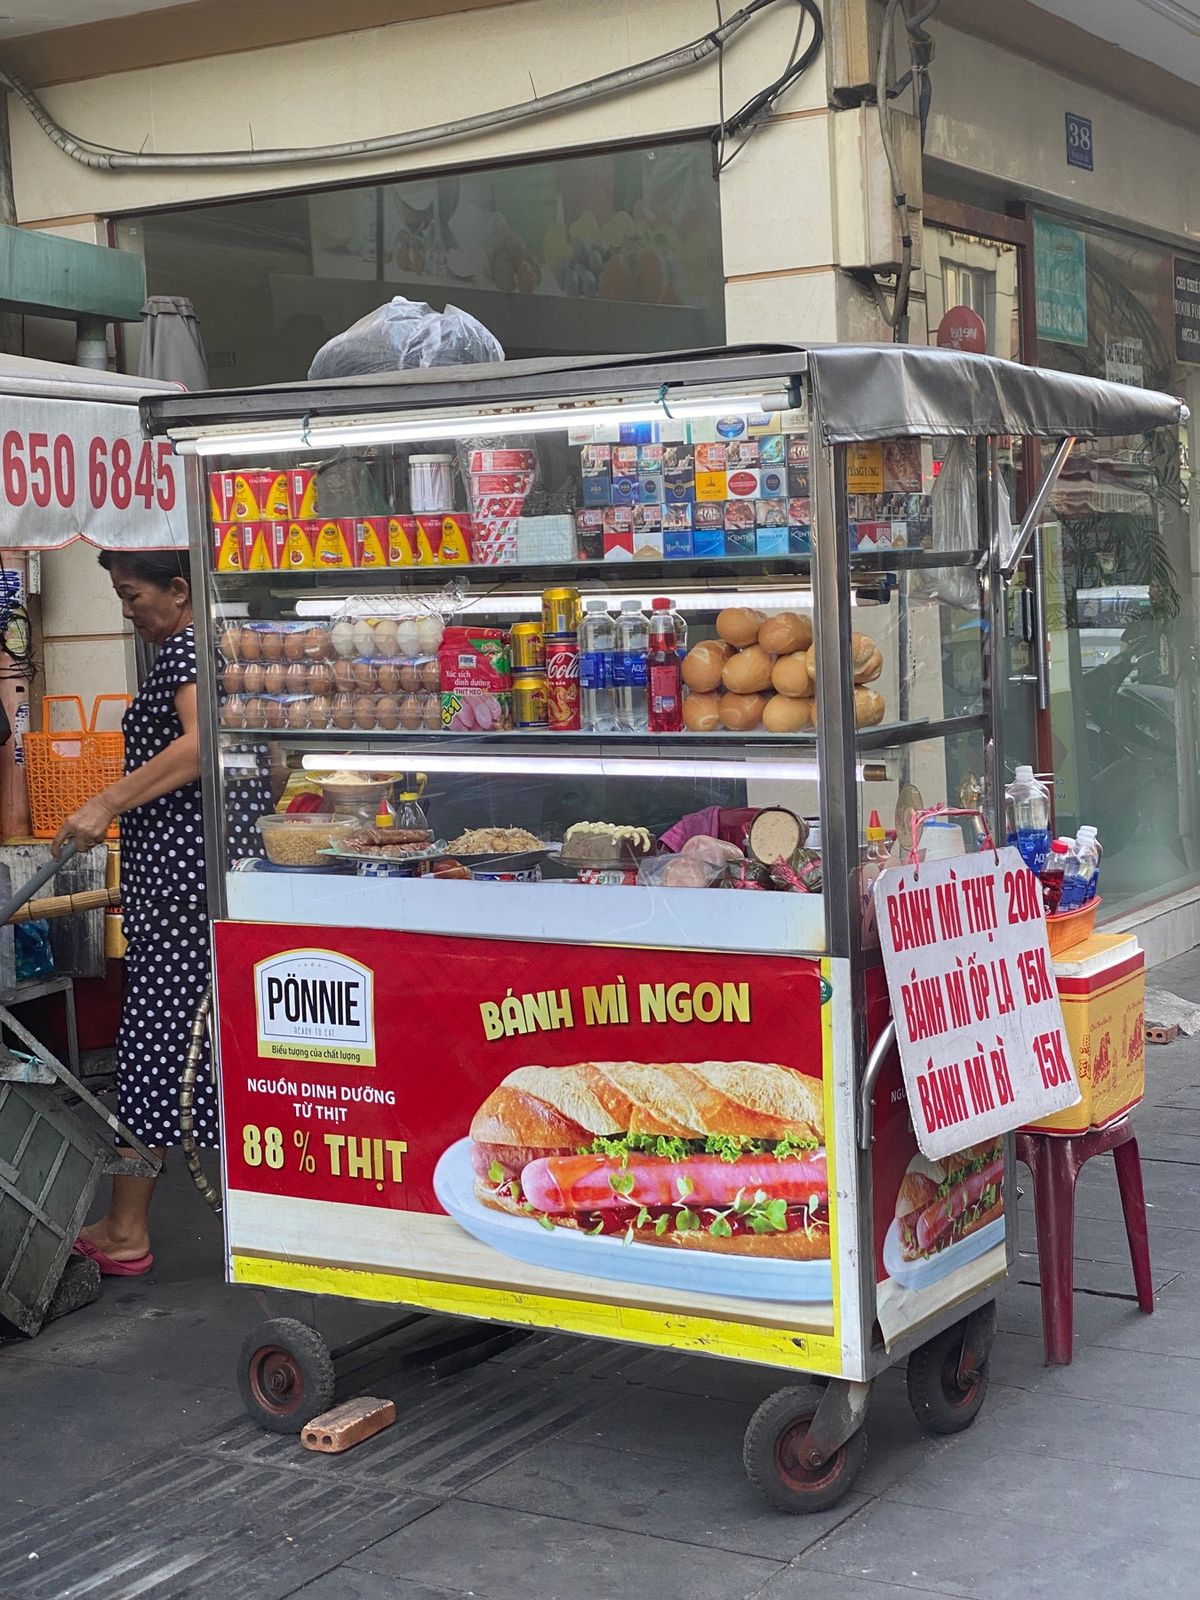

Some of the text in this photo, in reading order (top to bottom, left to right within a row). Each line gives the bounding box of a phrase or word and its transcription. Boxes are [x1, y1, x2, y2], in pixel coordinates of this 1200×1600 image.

[1069, 122, 1091, 151] 38
[3, 430, 176, 512] 650 6845
[886, 868, 1043, 953] BÁNH MÌ THỊT 20K
[267, 973, 360, 1027] PÖNNIE
[479, 976, 751, 1041] BÁNH MÌ NGON
[900, 947, 1054, 1043] BÁNH MÌ ỐP LA 15K
[272, 1044, 361, 1063] Biểu tượng của chất lượng
[916, 1056, 969, 1134] BÁNH
[965, 1041, 996, 1116] MÌ
[989, 1035, 1016, 1106] BÌ
[1032, 1030, 1072, 1090] 15K
[247, 1077, 396, 1105] NGUỒN DINH DƯỠNG
[293, 1102, 348, 1125] TỪ THỊT
[242, 1124, 408, 1192] 88 % THỊT
